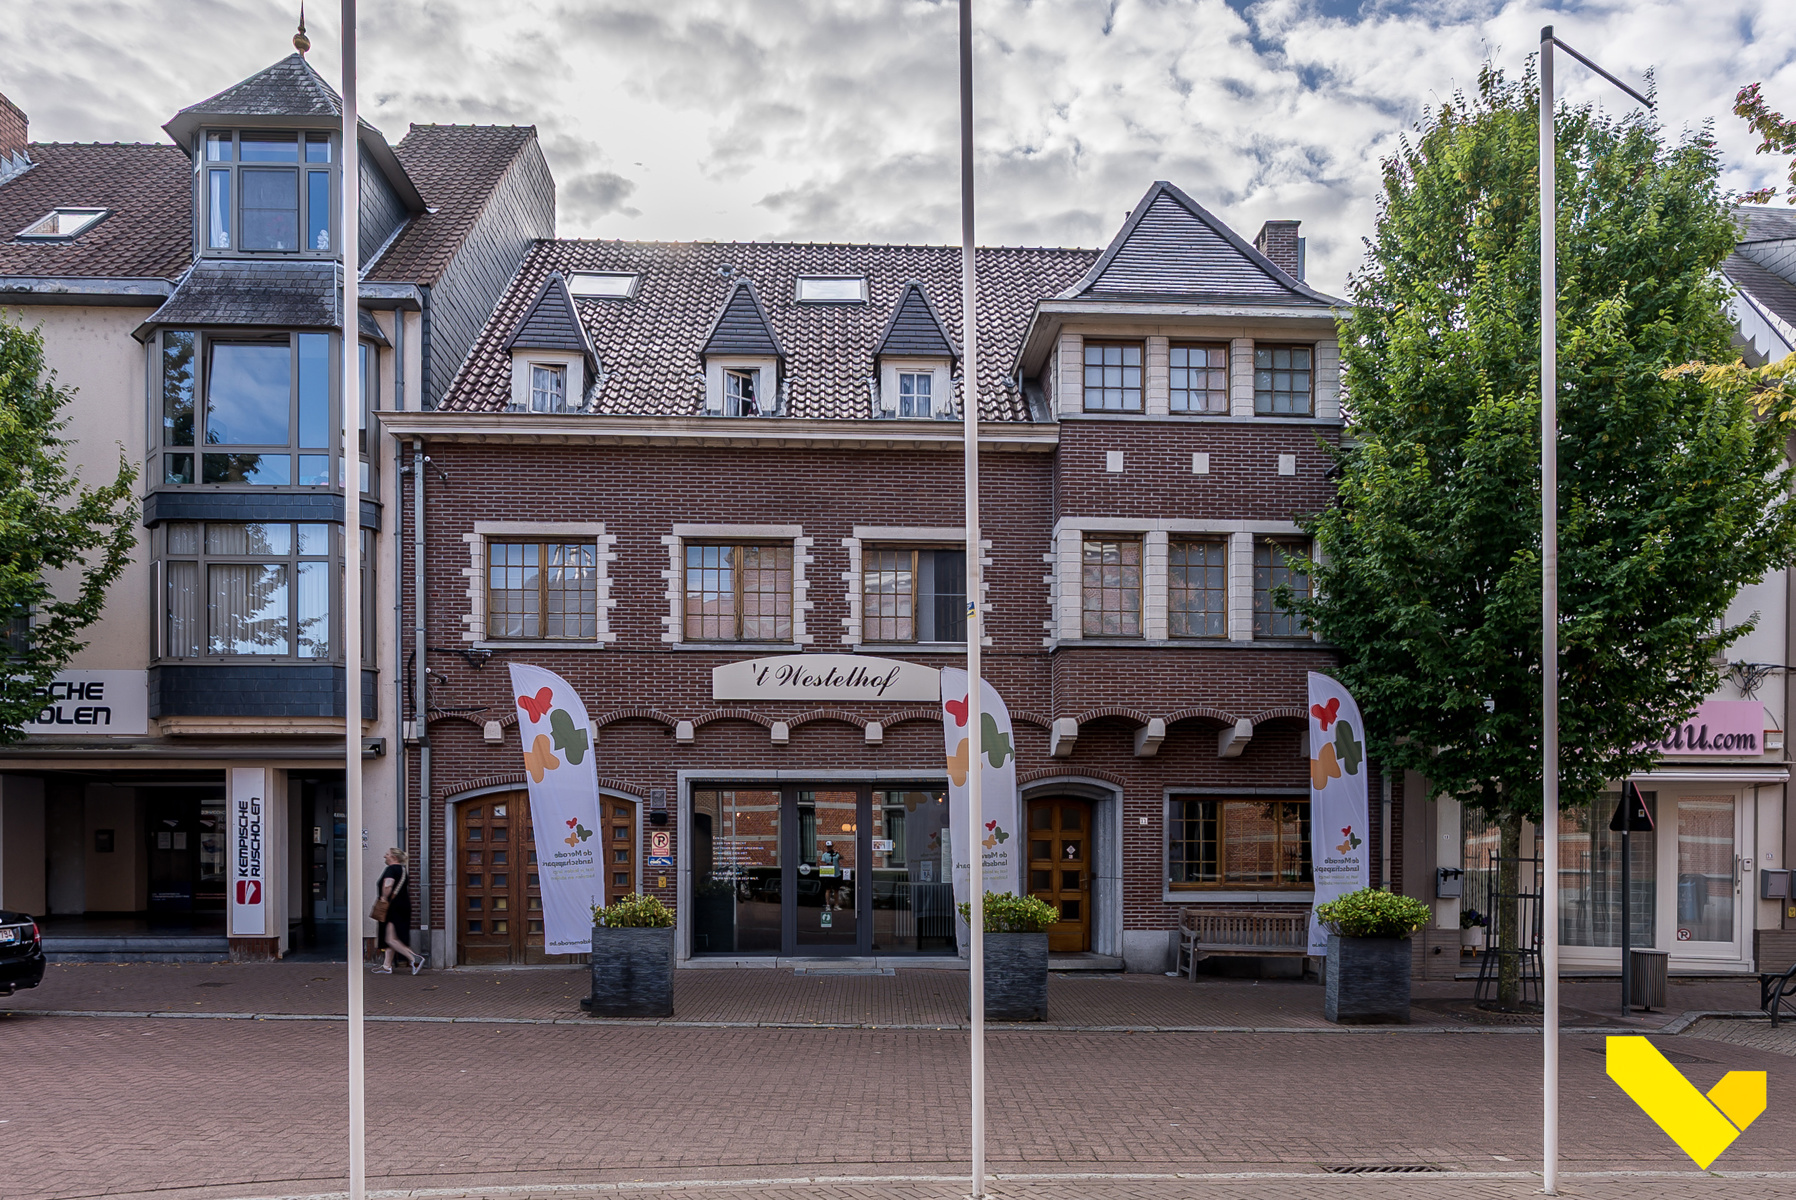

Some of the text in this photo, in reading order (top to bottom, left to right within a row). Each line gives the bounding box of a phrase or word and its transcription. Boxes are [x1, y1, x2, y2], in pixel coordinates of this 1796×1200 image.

[752, 663, 901, 697] 't Westelhof
[239, 801, 248, 877] KEMPISCHE
[251, 797, 261, 877] RIJSCHOLEN
